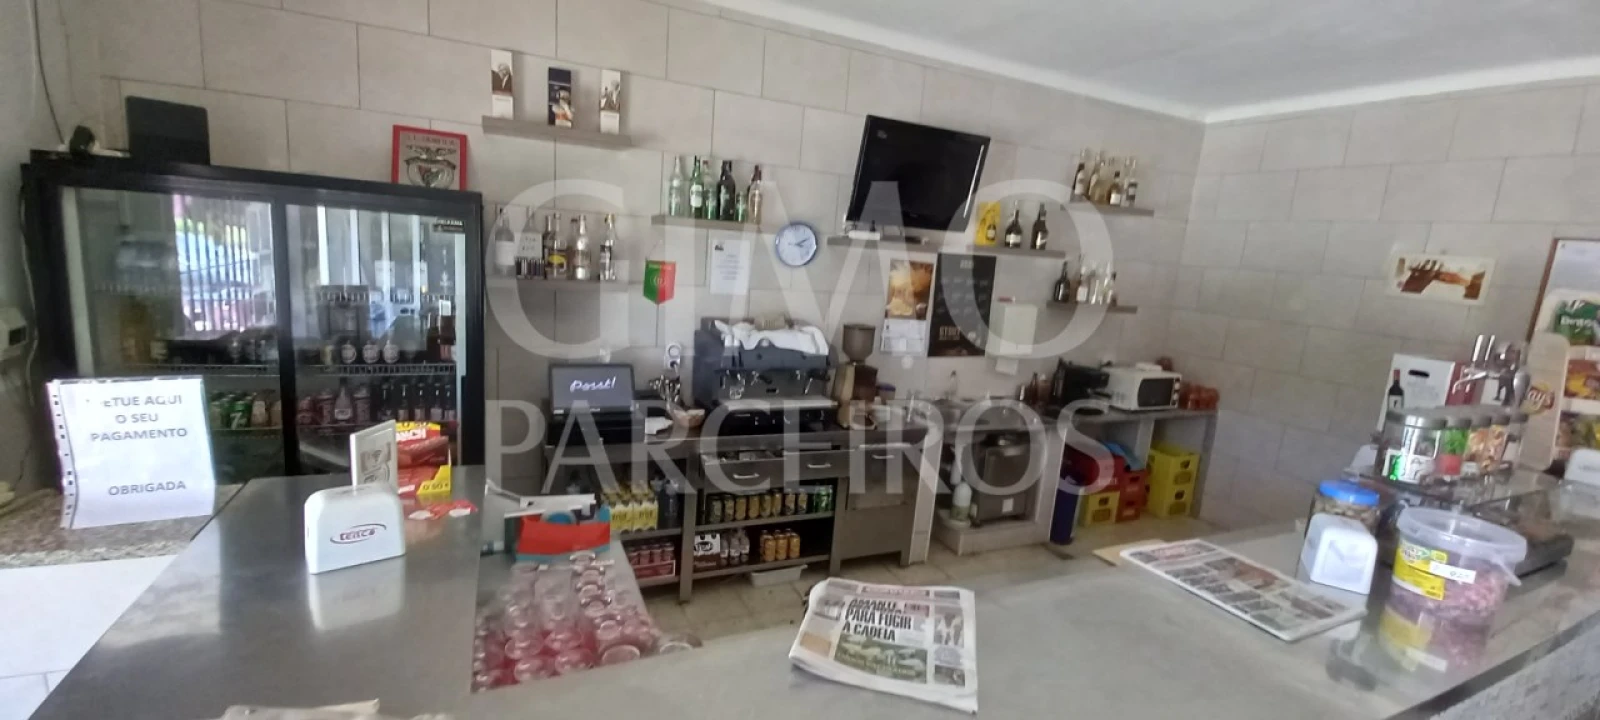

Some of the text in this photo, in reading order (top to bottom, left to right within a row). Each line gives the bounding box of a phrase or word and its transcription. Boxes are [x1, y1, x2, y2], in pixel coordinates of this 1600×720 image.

[115, 413, 158, 424] O SEU
[90, 428, 188, 442] PAGAMENTO
[108, 480, 187, 496] OBRIGADA
[845, 608, 912, 630] PARA FUGIR
[853, 624, 896, 642] CADEIA
